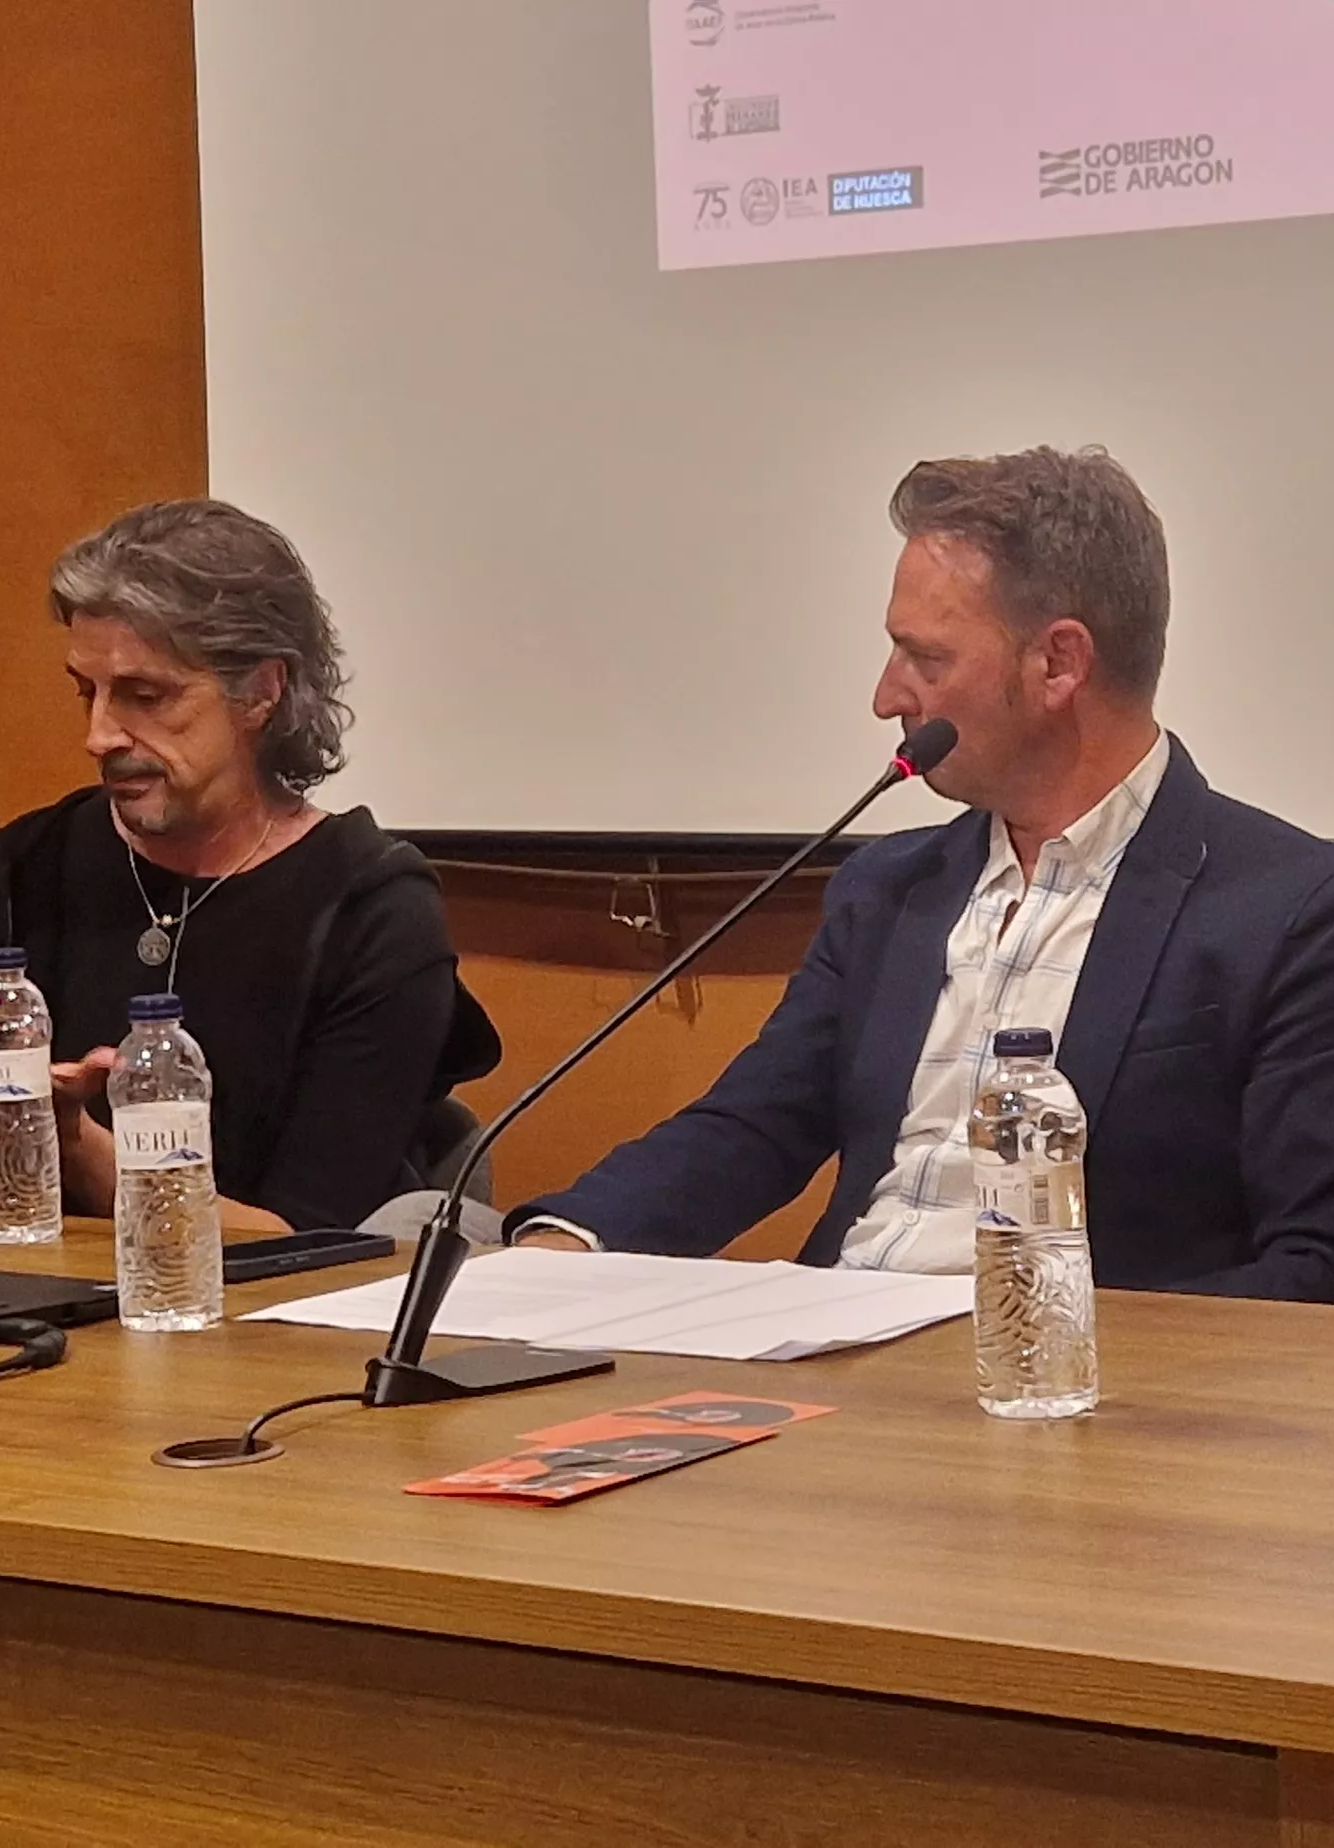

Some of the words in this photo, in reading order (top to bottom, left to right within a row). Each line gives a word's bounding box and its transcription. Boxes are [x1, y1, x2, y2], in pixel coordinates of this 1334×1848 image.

[1083, 133, 1215, 169] GOBIERNO
[782, 177, 818, 198] IEA
[832, 171, 911, 195] DIPUTACIÓN
[1084, 170, 1118, 196] DE
[1125, 158, 1234, 193] ARAGON
[832, 195, 852, 211] DE
[854, 190, 913, 209] HUESCA
